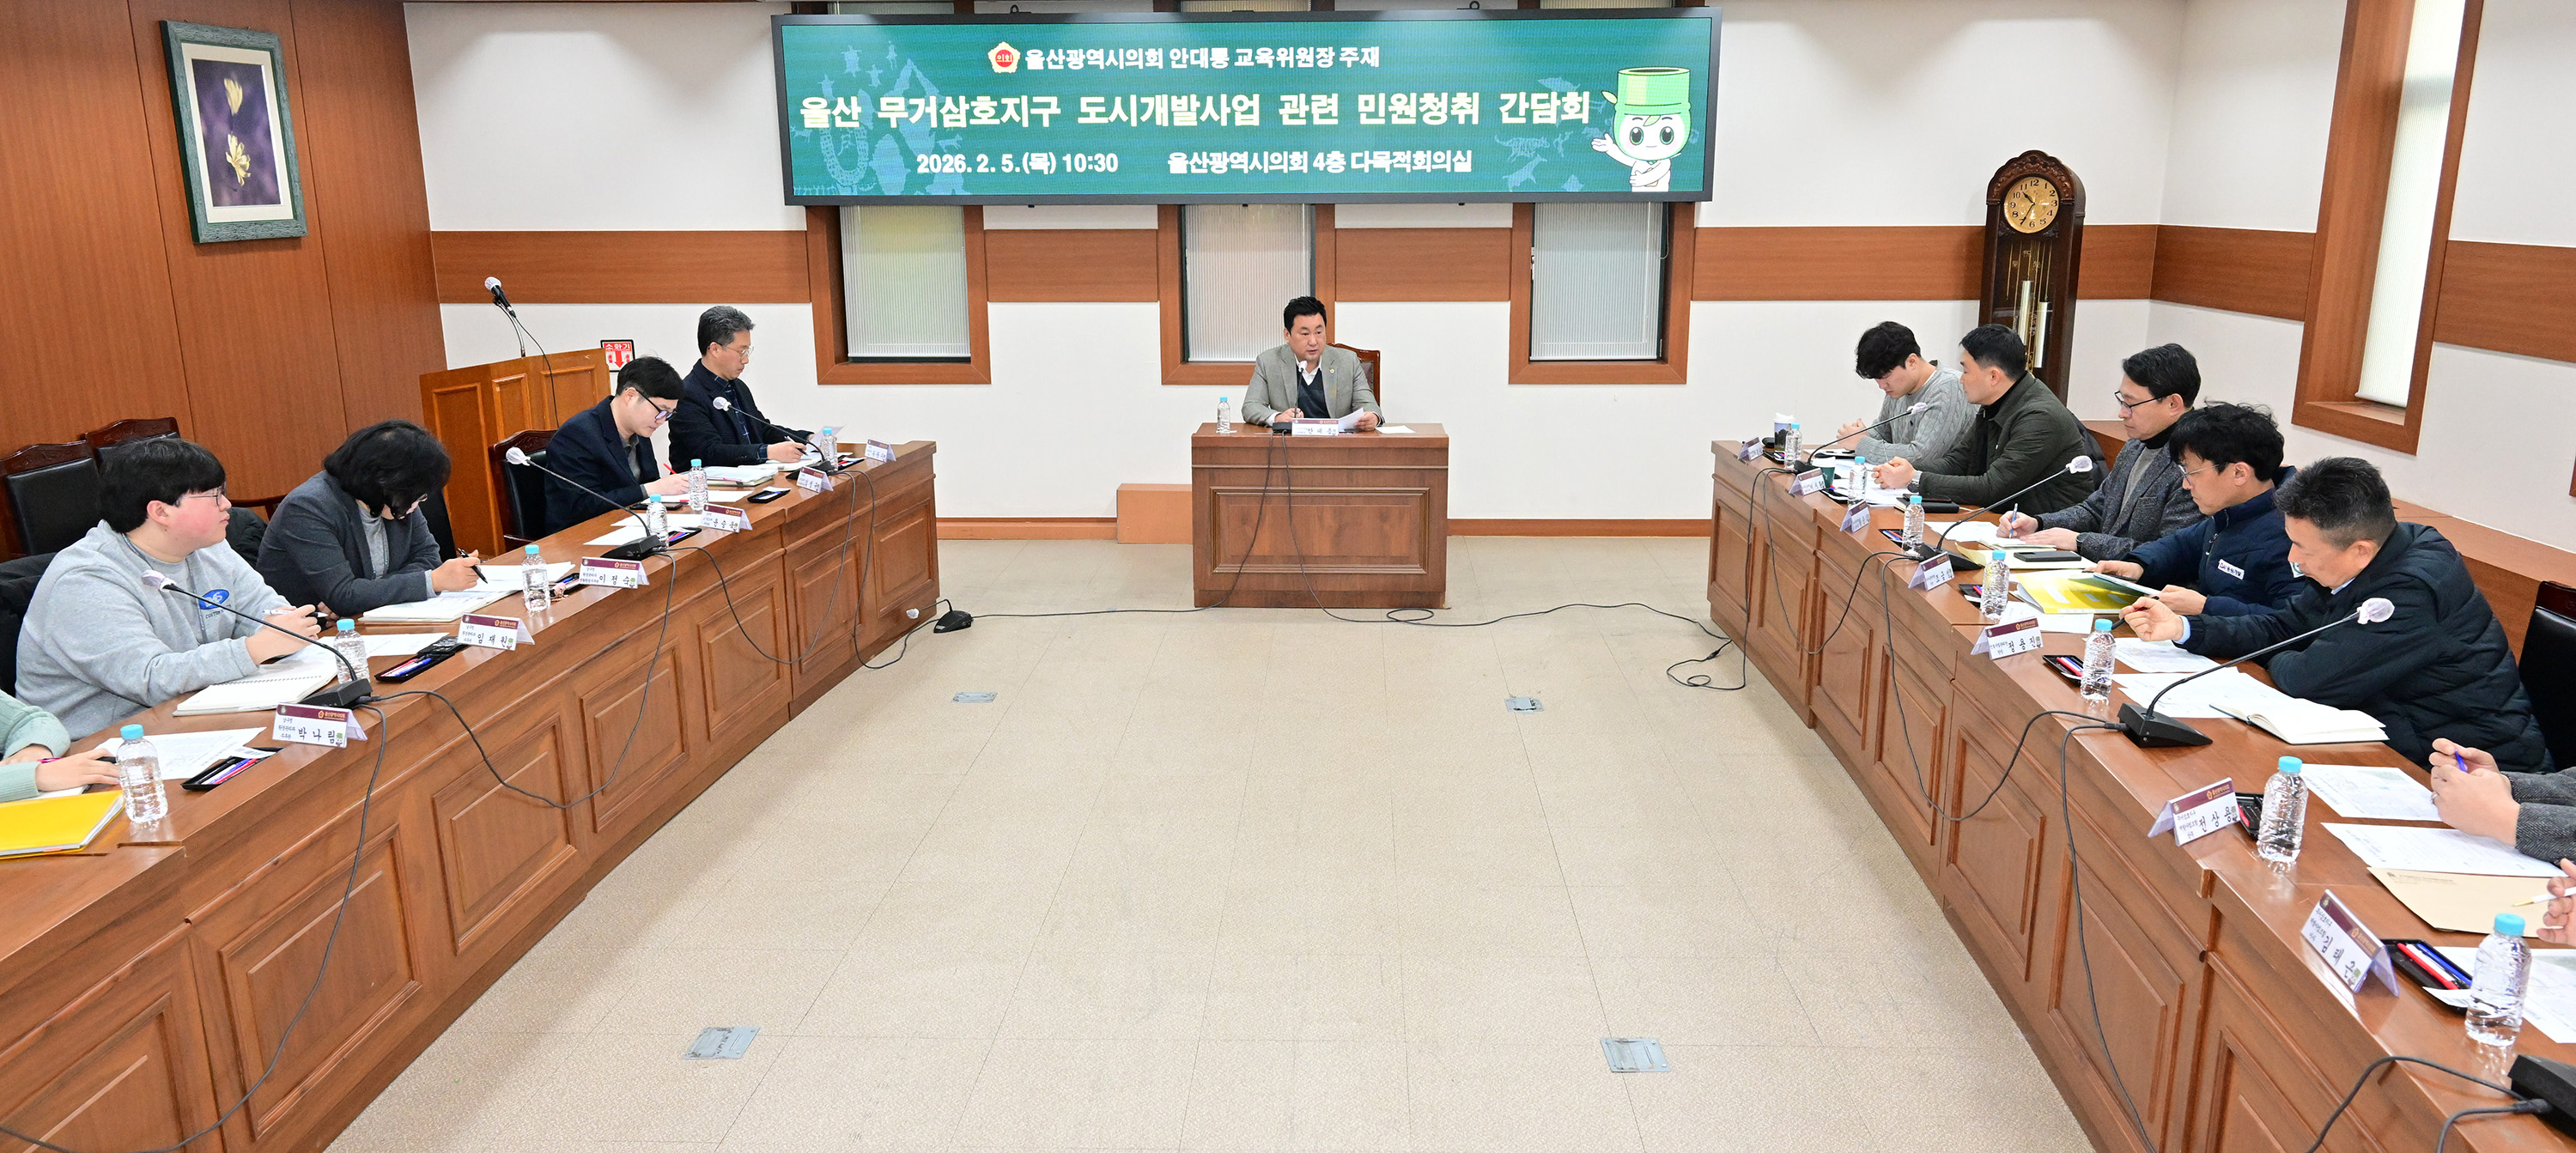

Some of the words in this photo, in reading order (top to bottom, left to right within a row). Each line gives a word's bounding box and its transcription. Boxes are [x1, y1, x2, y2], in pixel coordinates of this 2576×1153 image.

[1024, 47, 1163, 70] 울산광역시의회
[1234, 46, 1336, 69] 교육위원장
[1339, 46, 1380, 68] 주재
[799, 95, 862, 129] 울산
[878, 94, 1061, 128] 무거삼호지구
[1078, 94, 1260, 127] 도시개발사업
[1279, 93, 1339, 125] 관련
[1358, 92, 1479, 125] 민원청취
[1499, 91, 1590, 124] 간담회
[916, 154, 972, 173] 2026.
[1062, 153, 1119, 173] 10:30
[1167, 150, 1309, 174] 울산광역시의회
[1312, 150, 1347, 173] 4층
[1351, 149, 1473, 173] 다목적회의실
